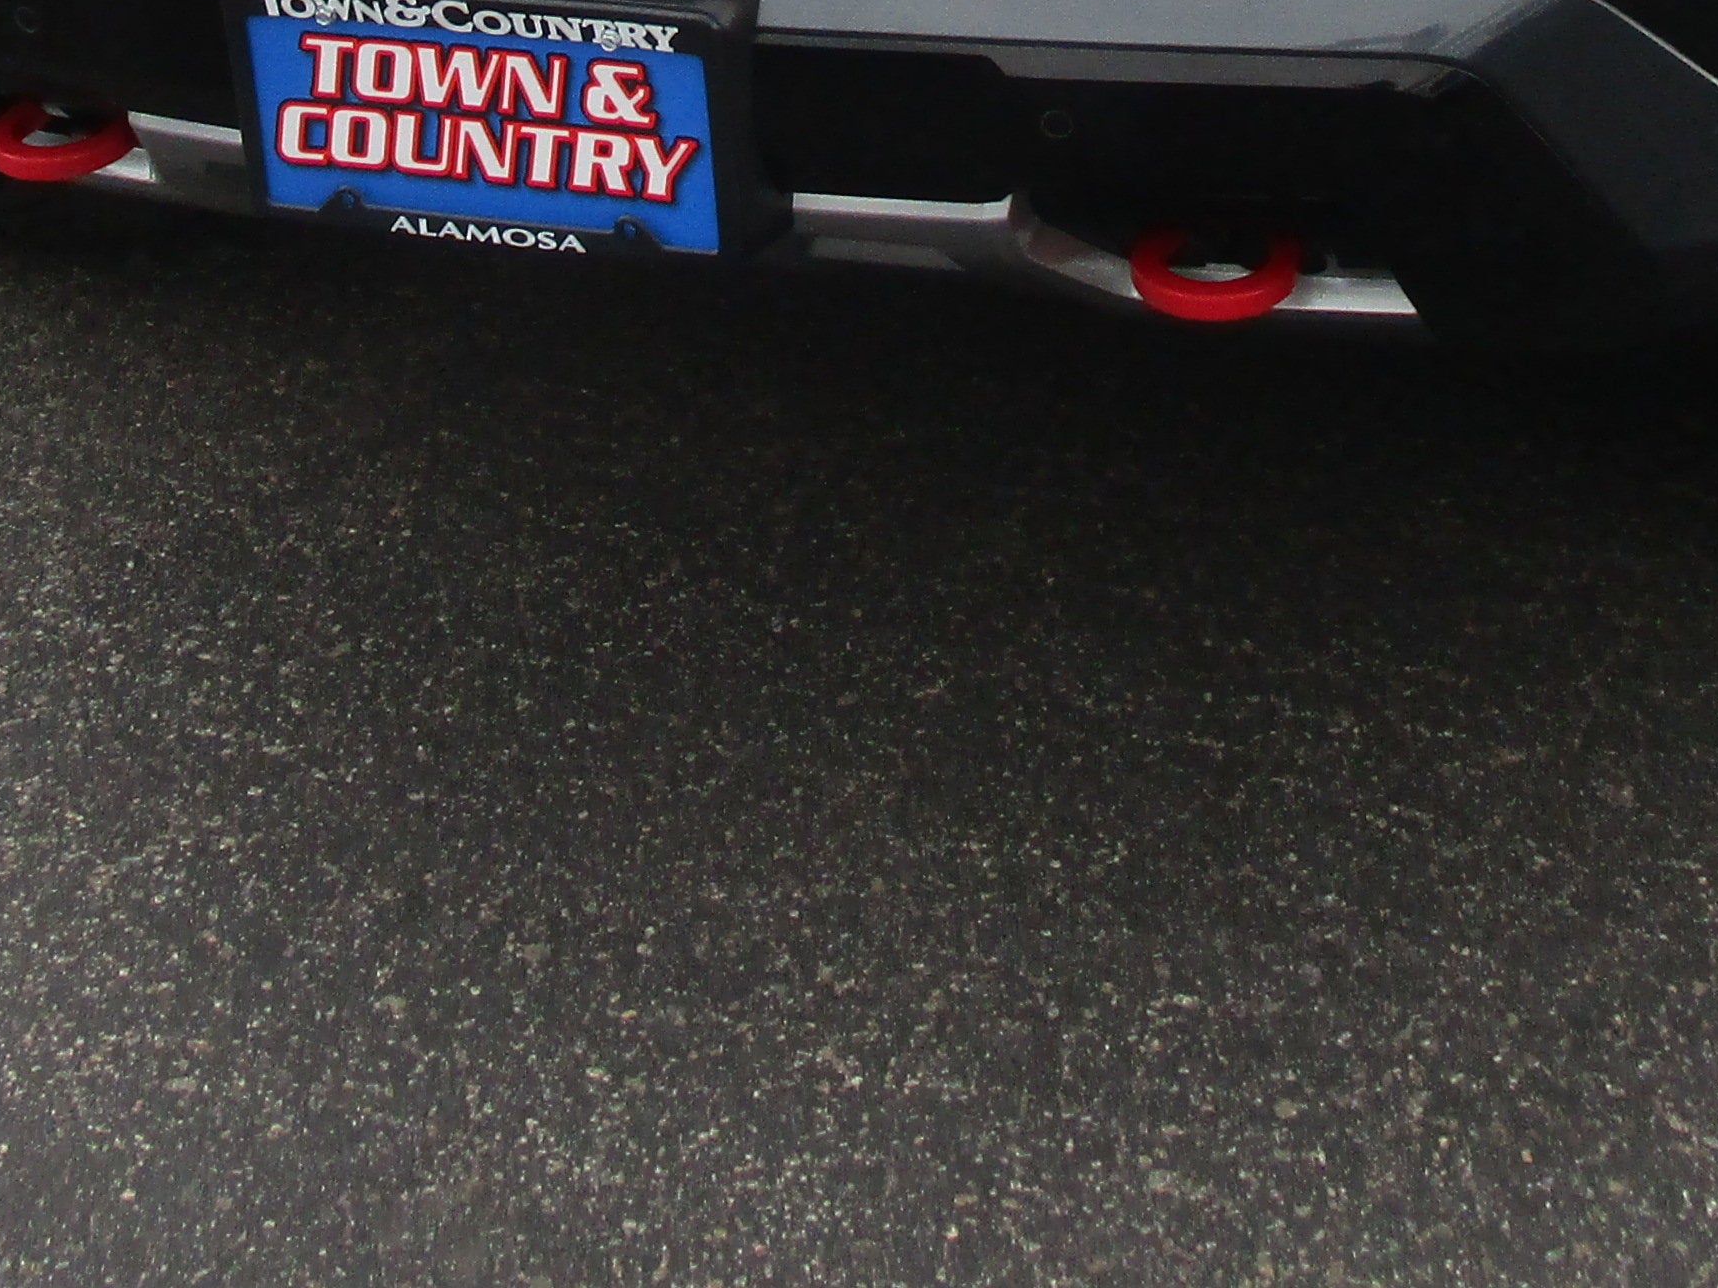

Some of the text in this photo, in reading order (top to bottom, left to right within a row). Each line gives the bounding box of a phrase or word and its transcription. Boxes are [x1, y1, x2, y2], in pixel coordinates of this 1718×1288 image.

[300, 33, 657, 131] TOWN &
[277, 101, 697, 203] COUNTRY
[390, 215, 586, 253] ALAMOSA
